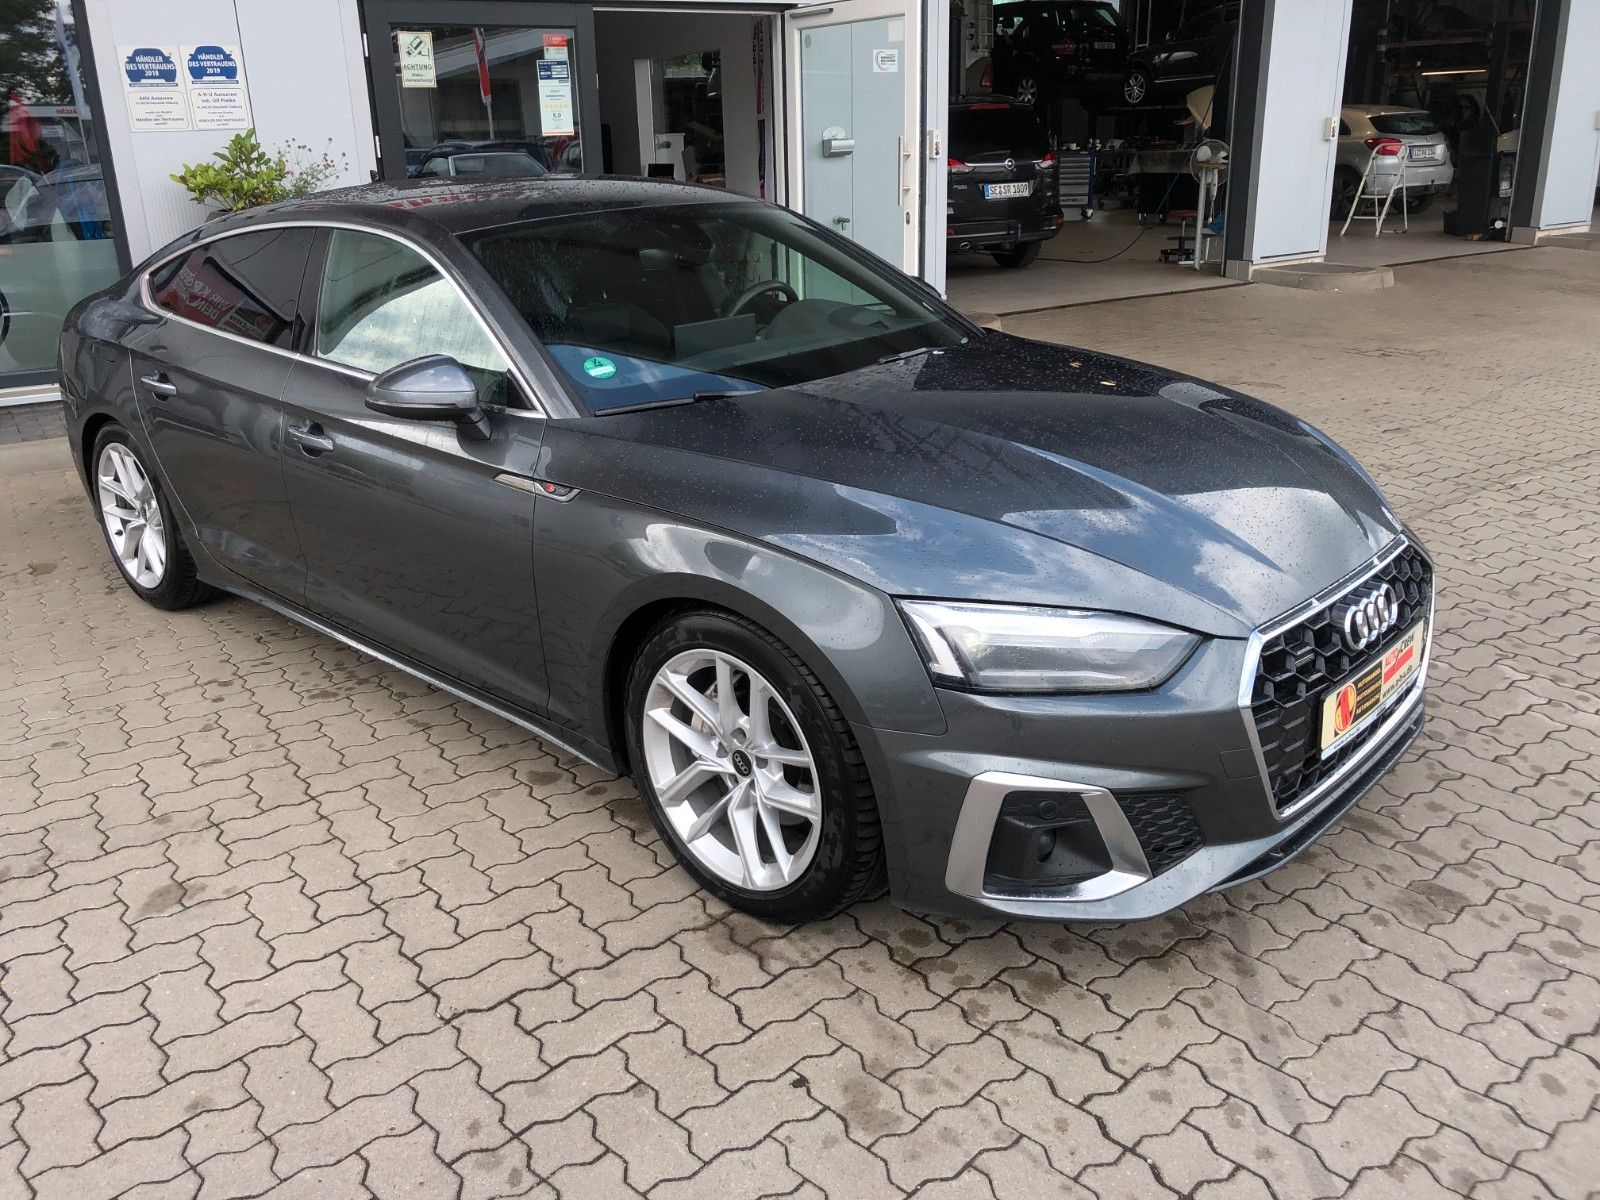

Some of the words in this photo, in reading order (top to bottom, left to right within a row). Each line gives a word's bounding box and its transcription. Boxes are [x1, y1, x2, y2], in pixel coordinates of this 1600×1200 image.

[135, 54, 163, 62] HÄNDLER
[990, 185, 998, 196] SE
[593, 358, 604, 367] 4
